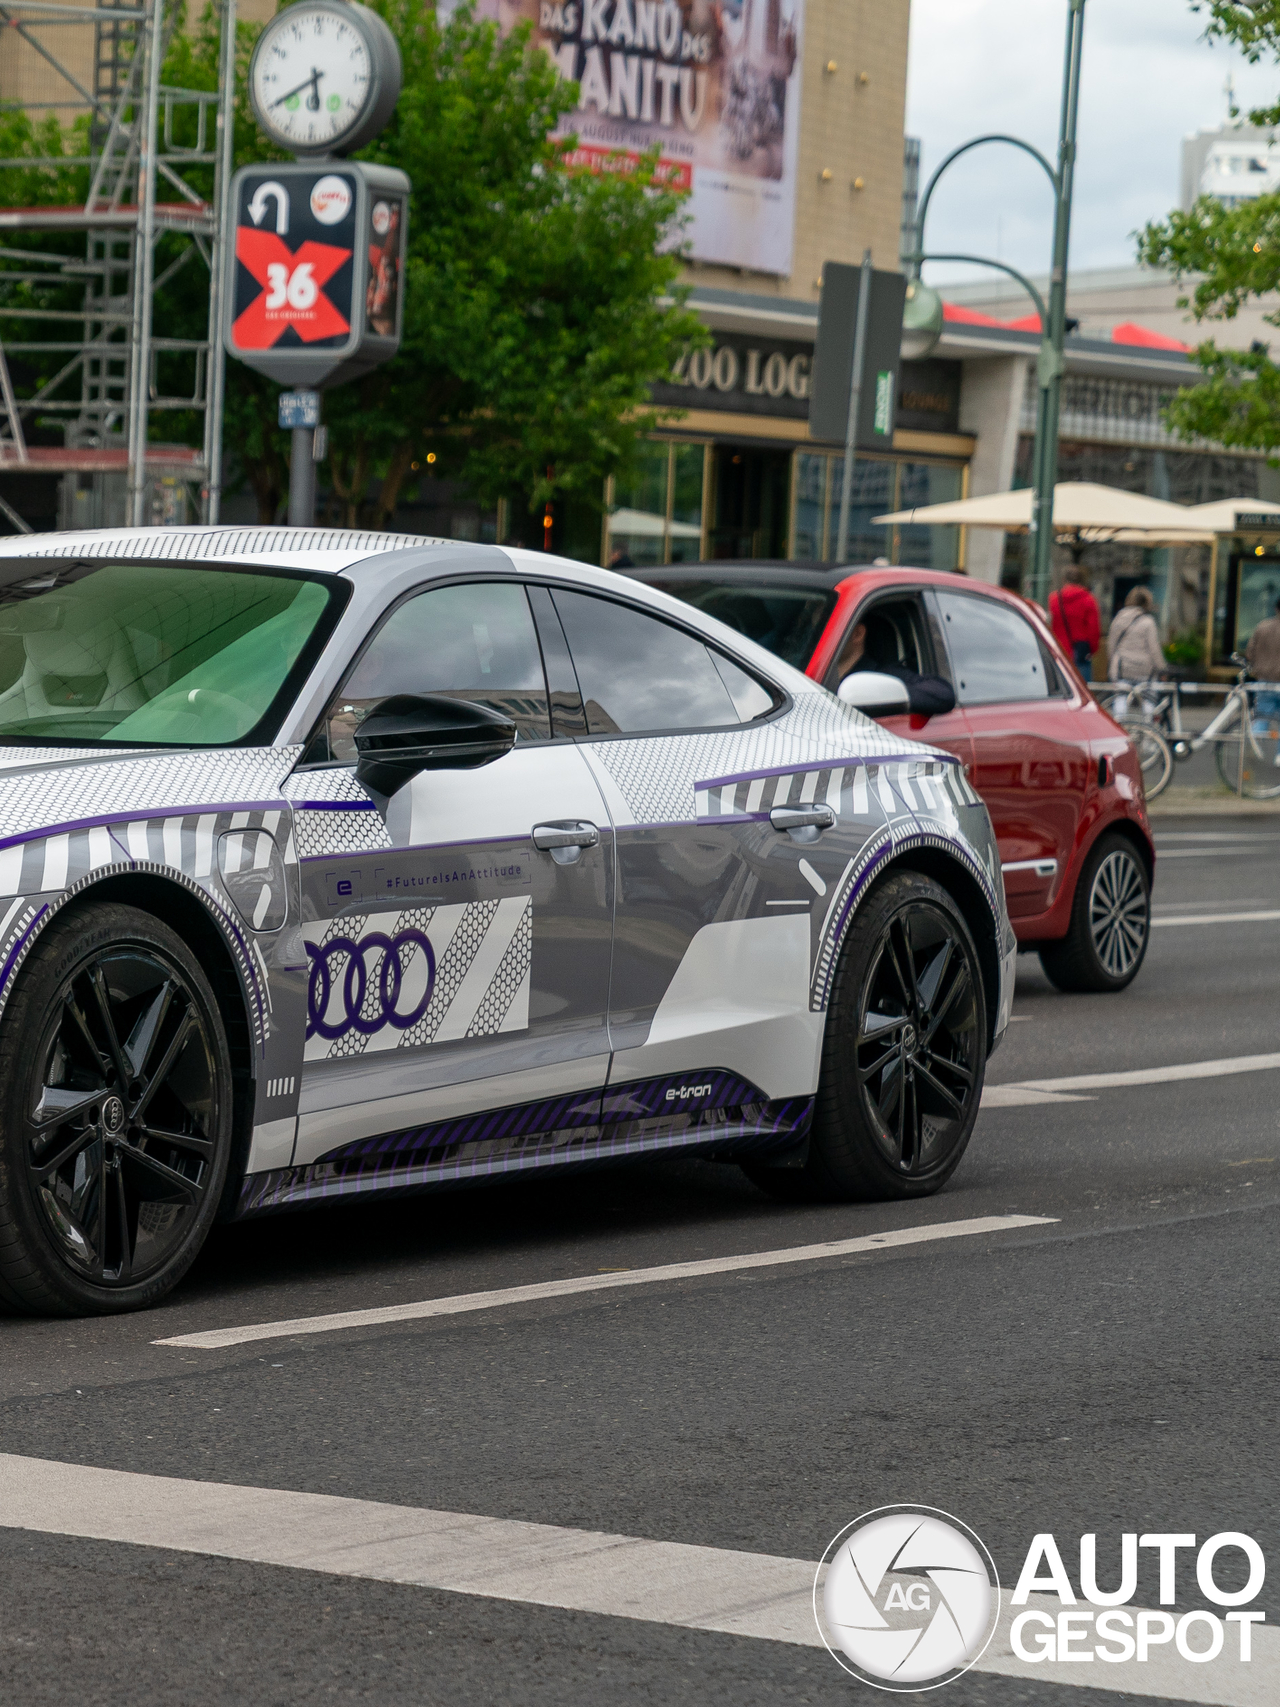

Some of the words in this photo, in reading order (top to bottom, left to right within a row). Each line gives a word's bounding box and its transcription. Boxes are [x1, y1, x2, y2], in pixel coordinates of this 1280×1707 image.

[539, 2, 578, 34] DAS
[265, 262, 318, 310] 36
[671, 345, 738, 392] ZOO
[746, 350, 812, 399] LOG
[386, 864, 521, 888] #FutureIsAnAttitude
[54, 928, 111, 979] GOODYEAR
[665, 1084, 712, 1101] e-tron
